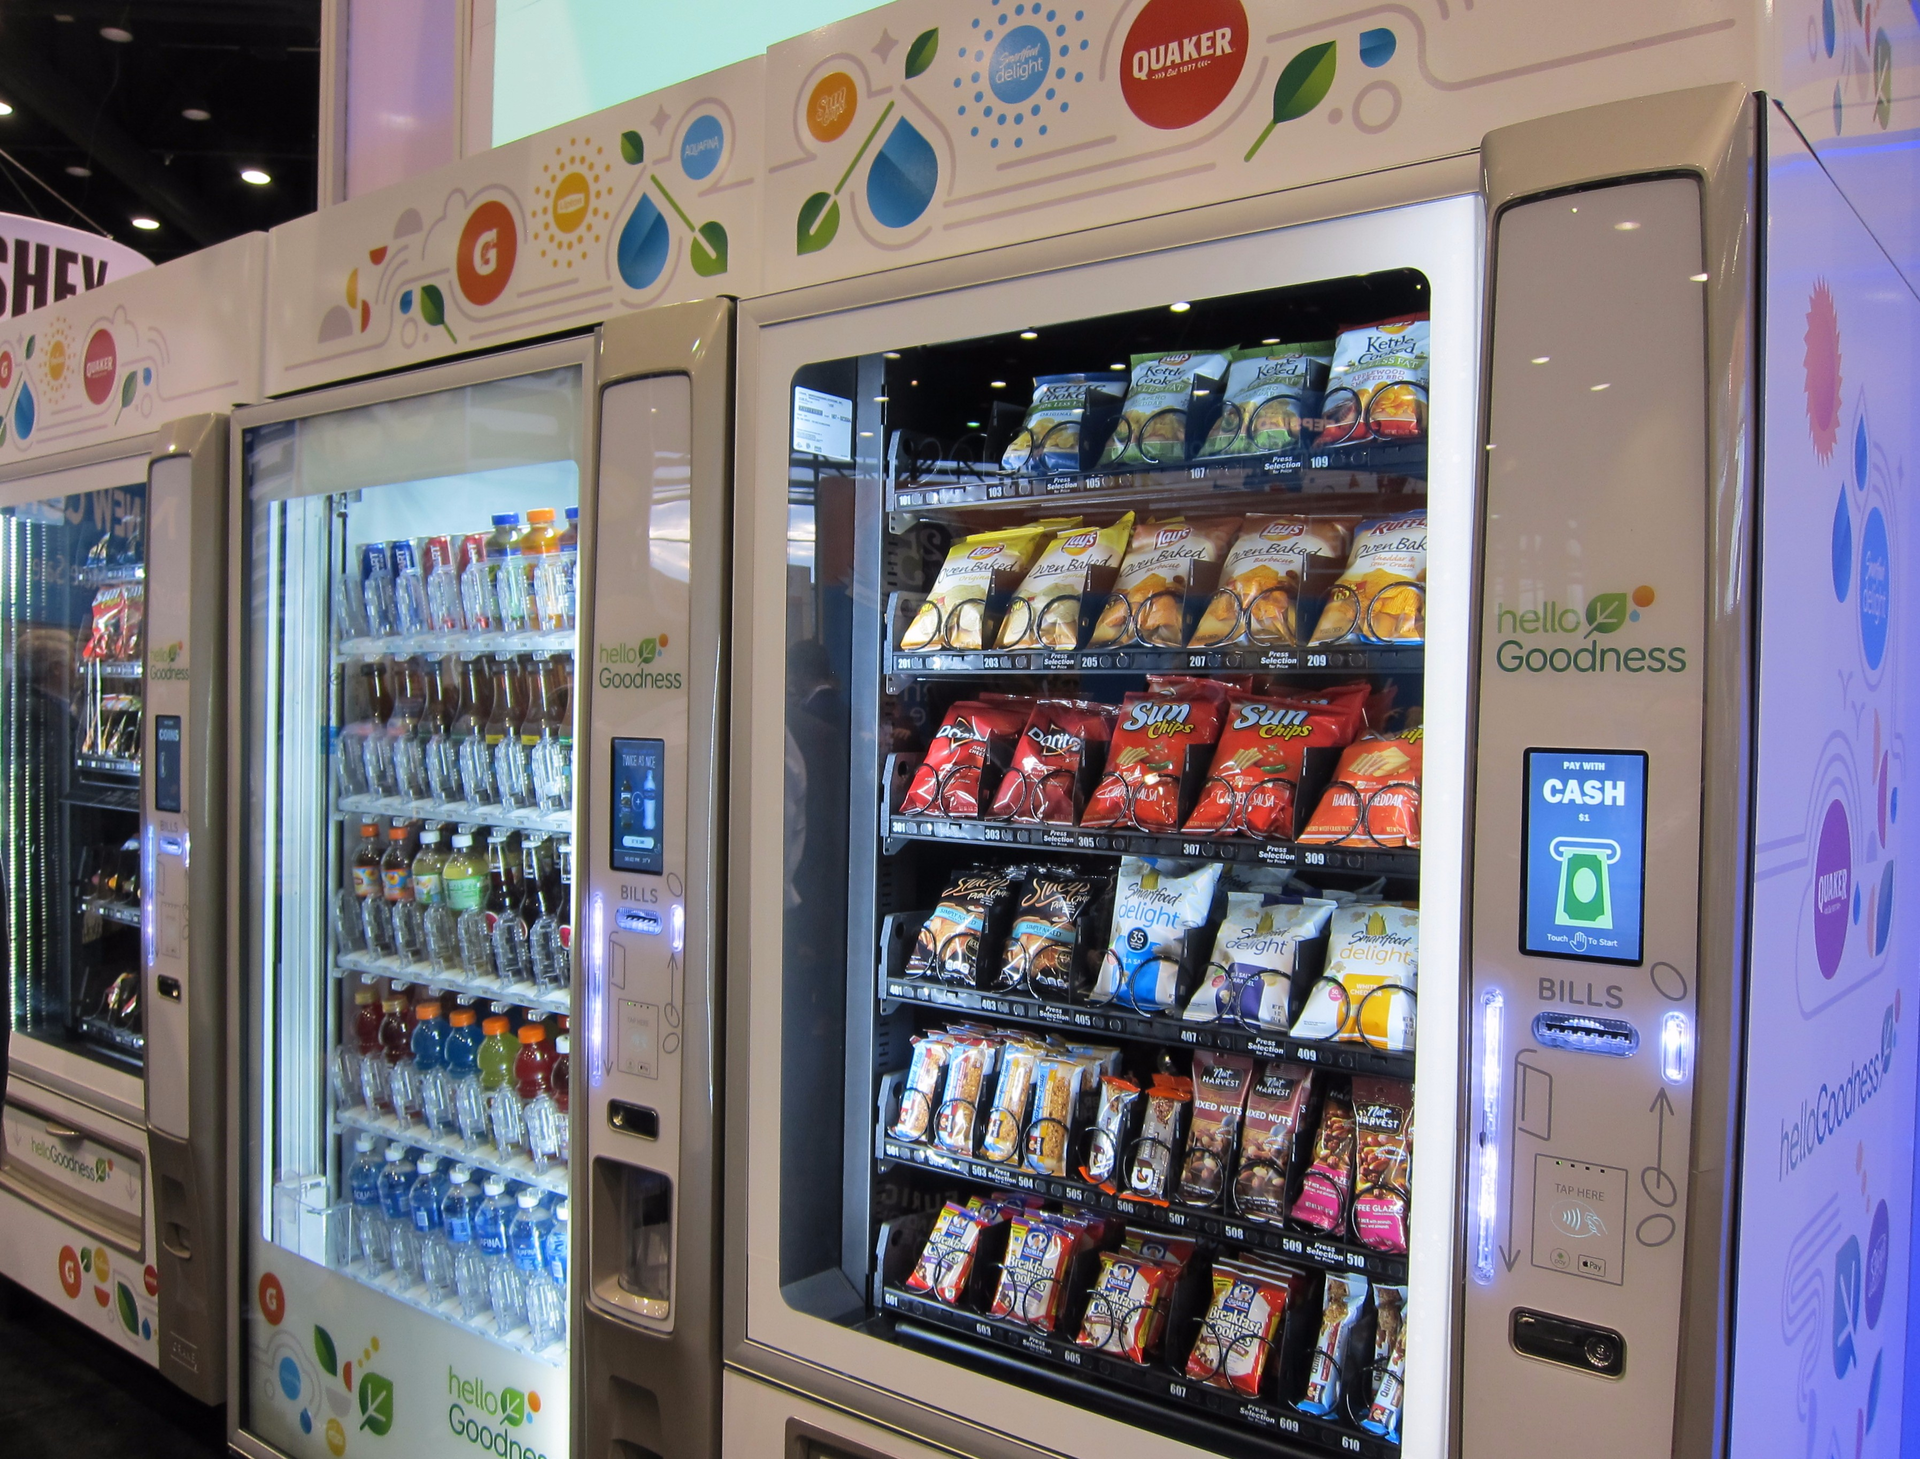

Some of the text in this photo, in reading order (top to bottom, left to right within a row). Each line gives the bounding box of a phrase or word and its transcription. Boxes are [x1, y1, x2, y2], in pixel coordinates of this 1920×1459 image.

[1132, 27, 1233, 80] QUAKER
[995, 57, 1044, 84] delight
[1179, 63, 1196, 74] 1877
[684, 136, 719, 158] AQUAFINA
[473, 228, 500, 276] G
[1366, 335, 1414, 352] Kettle
[86, 356, 113, 379] QUAKER
[1400, 356, 1418, 369] FAT
[1351, 369, 1406, 382] APPLEWOOD
[1387, 374, 1405, 382] BBQ
[1272, 455, 1293, 463] Press
[1310, 456, 1329, 468] 109
[1264, 461, 1301, 471] Selection
[1190, 468, 1206, 479] 107
[1047, 481, 1078, 490] Selection
[1085, 478, 1100, 489] 105
[988, 487, 1002, 498] 103
[899, 495, 911, 505] 101
[1355, 536, 1427, 559] Oven Bak
[1121, 545, 1206, 577] Oven Baked
[1252, 557, 1295, 565] Barbecue
[938, 558, 1018, 584] Oven Baked
[1029, 564, 1064, 579] Oven
[1863, 578, 1887, 626] delight
[1497, 601, 1581, 634] hello
[600, 643, 636, 664] hello
[1496, 639, 1687, 673] Goodness
[898, 658, 911, 668] 201
[984, 657, 999, 668] 203
[1044, 658, 1075, 666] Selection
[1081, 657, 1098, 668] 205
[1189, 656, 1206, 667] 207
[1260, 656, 1298, 665] Selection
[1307, 655, 1327, 666] 209
[150, 665, 190, 681] Goodness
[599, 667, 682, 689] Goodness
[1122, 701, 1191, 731] Sun
[1233, 704, 1308, 730] Sun
[158, 728, 180, 742] COINS
[1147, 720, 1194, 739] Chips
[1259, 723, 1313, 740] Chips
[1028, 727, 1081, 751] Dorito
[1563, 761, 1605, 772] PAY WITH
[1542, 778, 1626, 806] CASH
[1252, 793, 1275, 808] SALSA
[1578, 813, 1590, 822] $1
[159, 819, 179, 834] BILLS
[892, 822, 906, 833] 301
[1050, 829, 1068, 837] Press
[985, 829, 1000, 840] 303
[1044, 835, 1075, 844] Selection
[1078, 836, 1095, 848] 305
[1183, 844, 1200, 855] 307
[1266, 845, 1287, 853] Press
[1258, 851, 1295, 861] Selection
[1305, 852, 1325, 865] 309
[620, 884, 658, 904] BILLS
[1125, 882, 1182, 907] Smartfood
[1818, 868, 1847, 913] QUAKER
[939, 908, 957, 919] SIMPLY
[1118, 900, 1180, 929] delight
[1025, 923, 1040, 932] SIMPLY
[1130, 931, 1145, 944] 35
[1348, 930, 1412, 947] Smartfood
[1547, 933, 1618, 948] Touch To Start
[1226, 938, 1287, 956] delight
[1340, 945, 1412, 966] delight
[889, 985, 903, 996] 401
[1538, 977, 1624, 1009] BILLS
[982, 1000, 997, 1011] 403
[1045, 1005, 1063, 1014] Press
[1039, 1010, 1070, 1021] Selection
[1074, 1014, 1091, 1026] 405
[1181, 1031, 1197, 1043] 407
[1256, 1038, 1276, 1046] Press
[1247, 1043, 1284, 1055] Selection
[1297, 1049, 1317, 1062] 409
[1213, 1067, 1234, 1078] Nut
[1202, 1076, 1240, 1087] HARVEST
[1266, 1077, 1286, 1088] Nut
[1256, 1084, 1290, 1097] HARVEST
[1219, 1105, 1243, 1115] NUTS
[1367, 1105, 1392, 1118] Nut
[1268, 1115, 1292, 1126] NUTS
[1356, 1115, 1400, 1129] HARVEST
[886, 1145, 899, 1157] 501
[972, 1165, 987, 1178] 503
[994, 1167, 1011, 1177] Press
[1131, 1166, 1154, 1190] G
[988, 1172, 1016, 1185] Selection
[1018, 1176, 1034, 1189] 504
[1066, 1187, 1082, 1200] 505
[1555, 1183, 1605, 1202] TAP HERE
[1117, 1201, 1134, 1214] 506
[1169, 1213, 1185, 1226] 507
[1225, 1226, 1244, 1240] 508
[1282, 1239, 1302, 1253] 509
[1315, 1241, 1336, 1253] Press
[1306, 1247, 1344, 1262] Selection
[1347, 1254, 1364, 1268] 510
[1007, 1255, 1054, 1279] Breakfast
[1589, 1261, 1602, 1272] Pay
[64, 1263, 75, 1284] G
[266, 1288, 277, 1311] G
[885, 1294, 898, 1307] 601
[1226, 1298, 1249, 1309] QUAKER
[1209, 1306, 1262, 1335] Breakfast
[976, 1324, 992, 1337] 603
[1206, 1320, 1253, 1348] Cookies
[1022, 1339, 1052, 1354] Selection
[1028, 1336, 1046, 1346] Press
[1065, 1350, 1081, 1364] 605
[448, 1363, 498, 1417] hello
[1170, 1384, 1187, 1398] 607
[1239, 1408, 1275, 1424] Selection
[1248, 1404, 1268, 1415] Press
[1279, 1418, 1299, 1433] 609
[1342, 1436, 1360, 1452] 610
